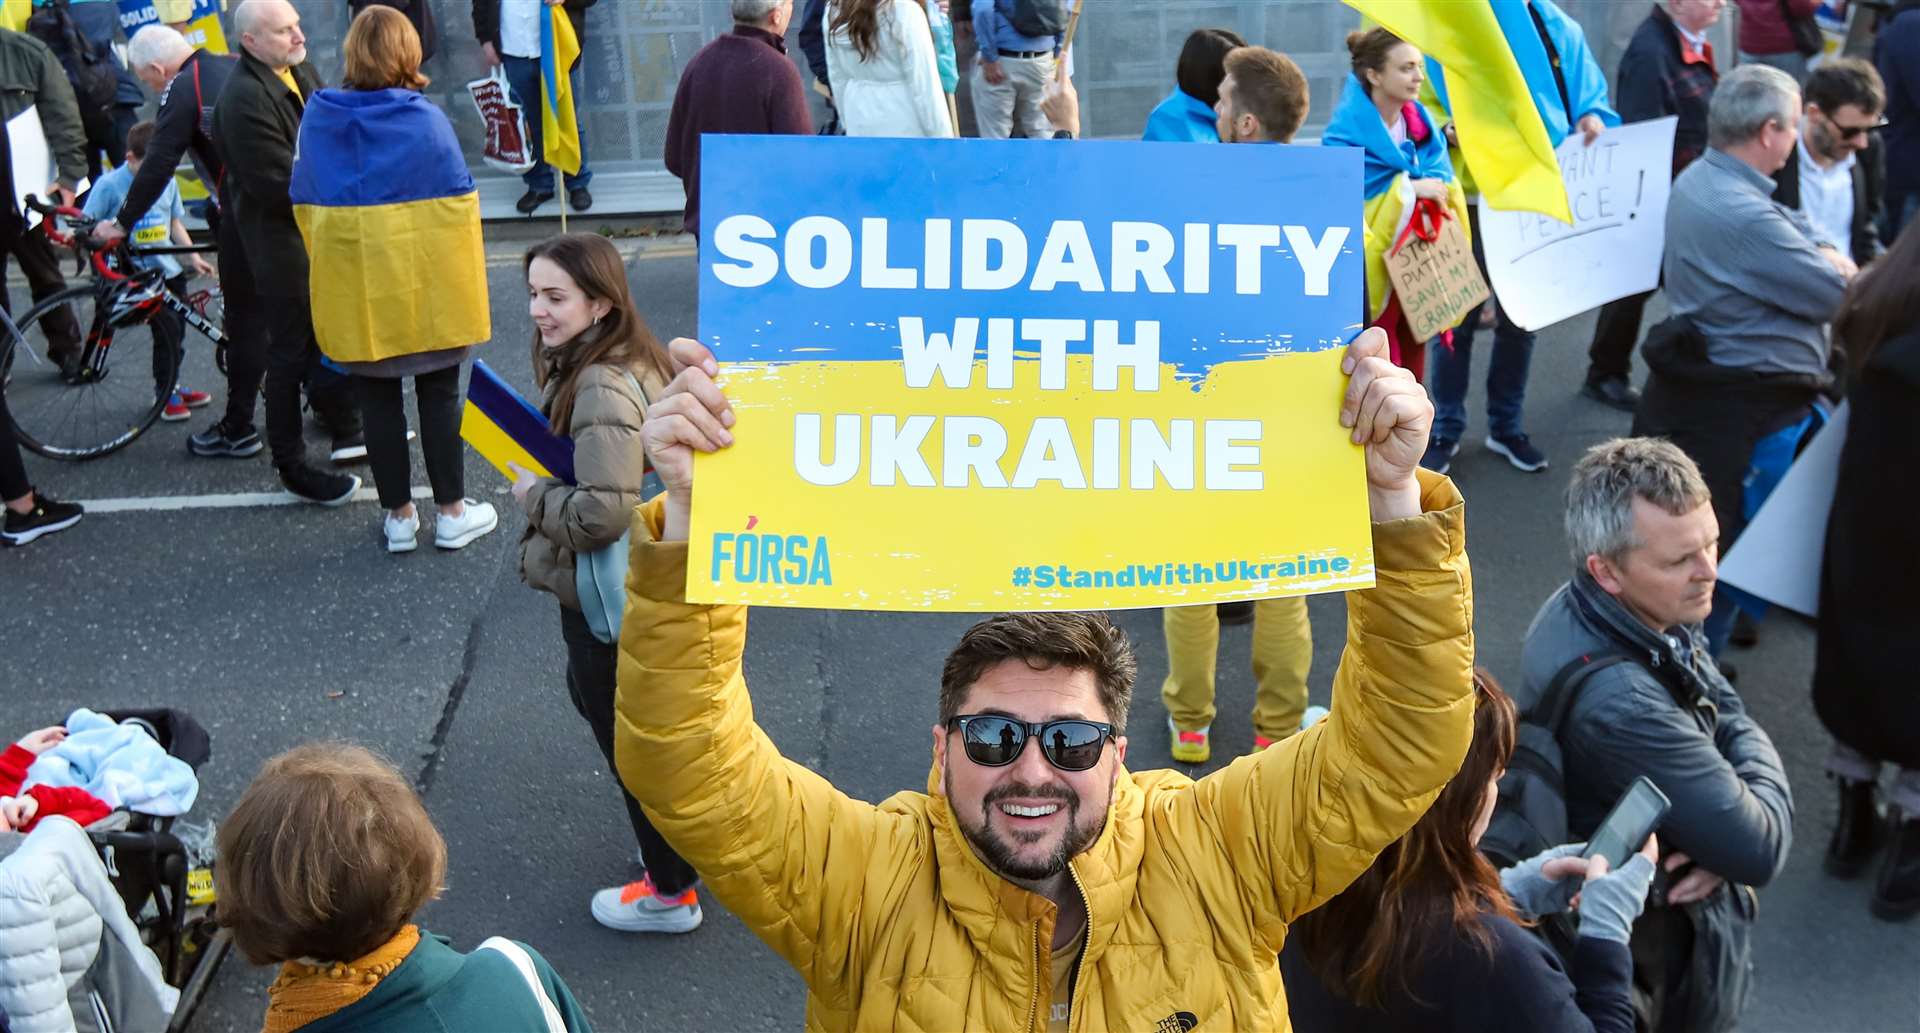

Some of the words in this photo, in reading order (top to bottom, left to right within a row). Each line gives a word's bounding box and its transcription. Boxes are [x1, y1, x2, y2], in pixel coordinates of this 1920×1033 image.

[1517, 170, 1645, 242] PECE!
[711, 214, 1350, 296] SOLIDARITY
[1398, 238, 1434, 268] STO
[1406, 276, 1448, 313] SAVE
[1449, 260, 1468, 280] MY
[898, 316, 1160, 392] WITH
[793, 412, 1264, 490] UKRAINE
[710, 515, 832, 586] FÓRSA
[1012, 553, 1349, 588] #StandWithUkraine
[1156, 1012, 1178, 1029] THE
